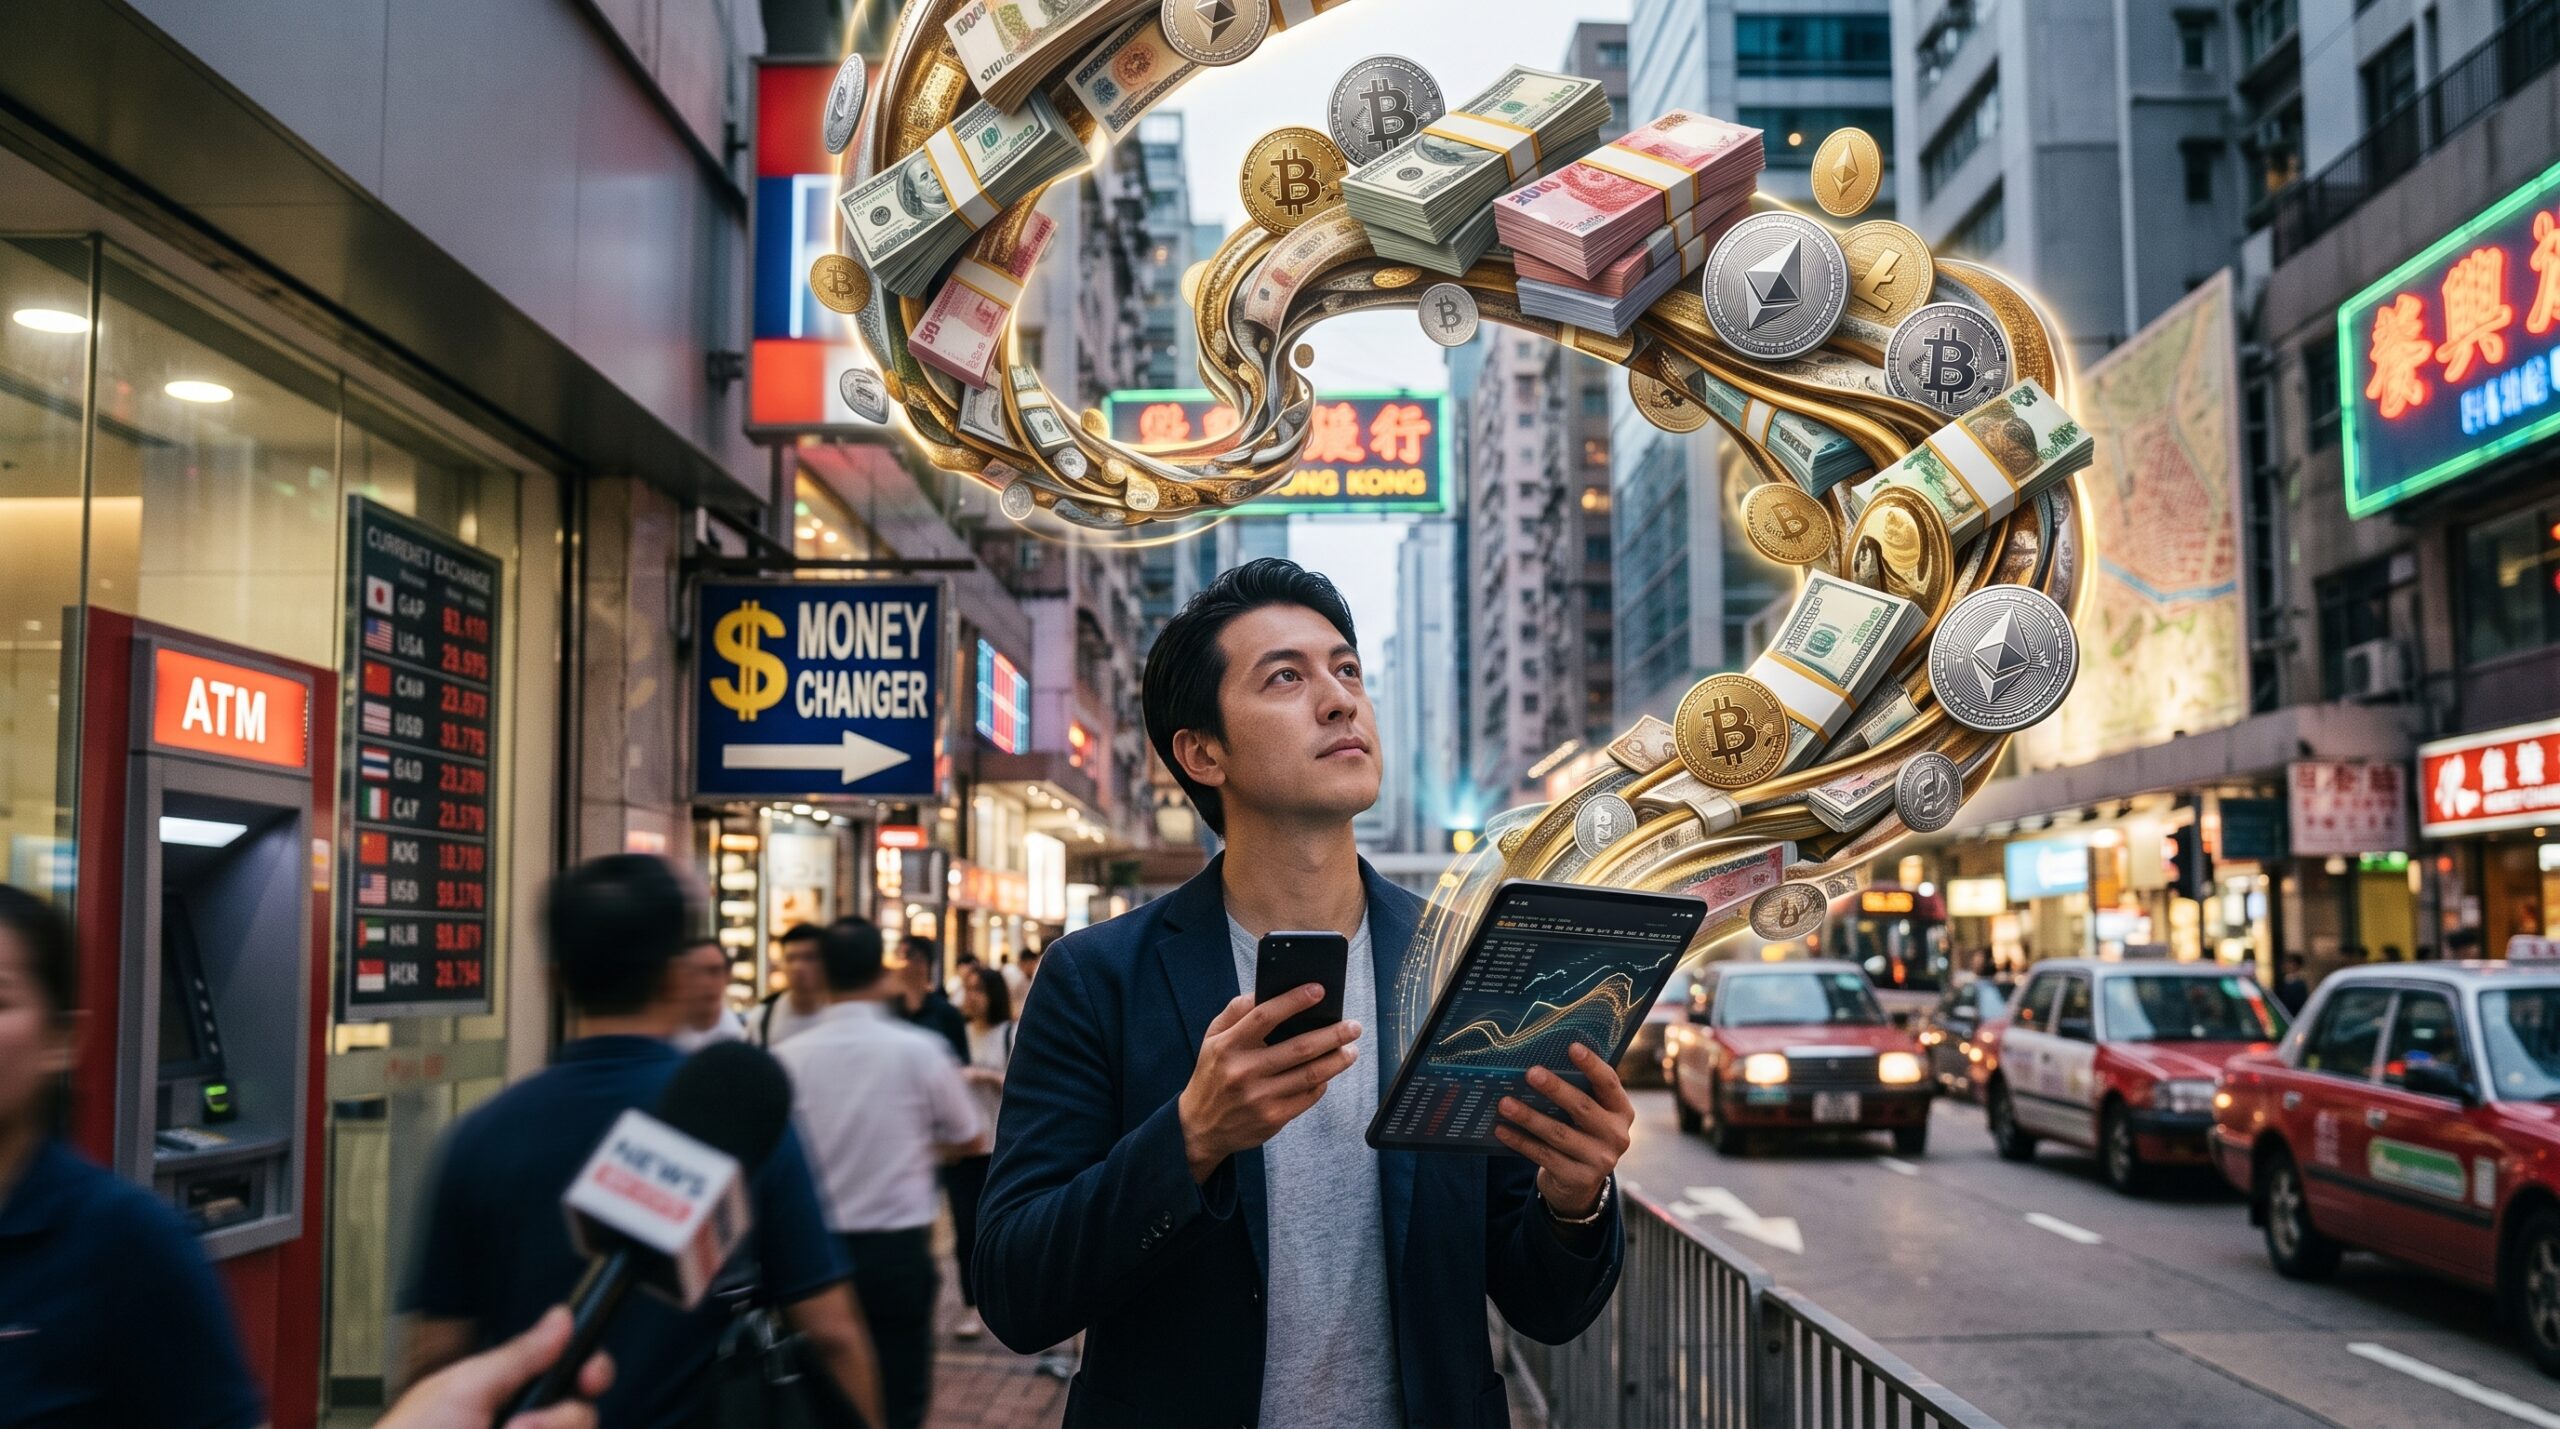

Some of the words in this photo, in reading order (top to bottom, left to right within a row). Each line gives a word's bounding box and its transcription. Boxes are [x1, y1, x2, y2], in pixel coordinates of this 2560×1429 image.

[1346, 467, 1427, 496] KONG
[797, 601, 928, 660] MONEY
[182, 676, 267, 744] ATM
[795, 669, 929, 719] CHANGER
[614, 1139, 708, 1198] NEWS
